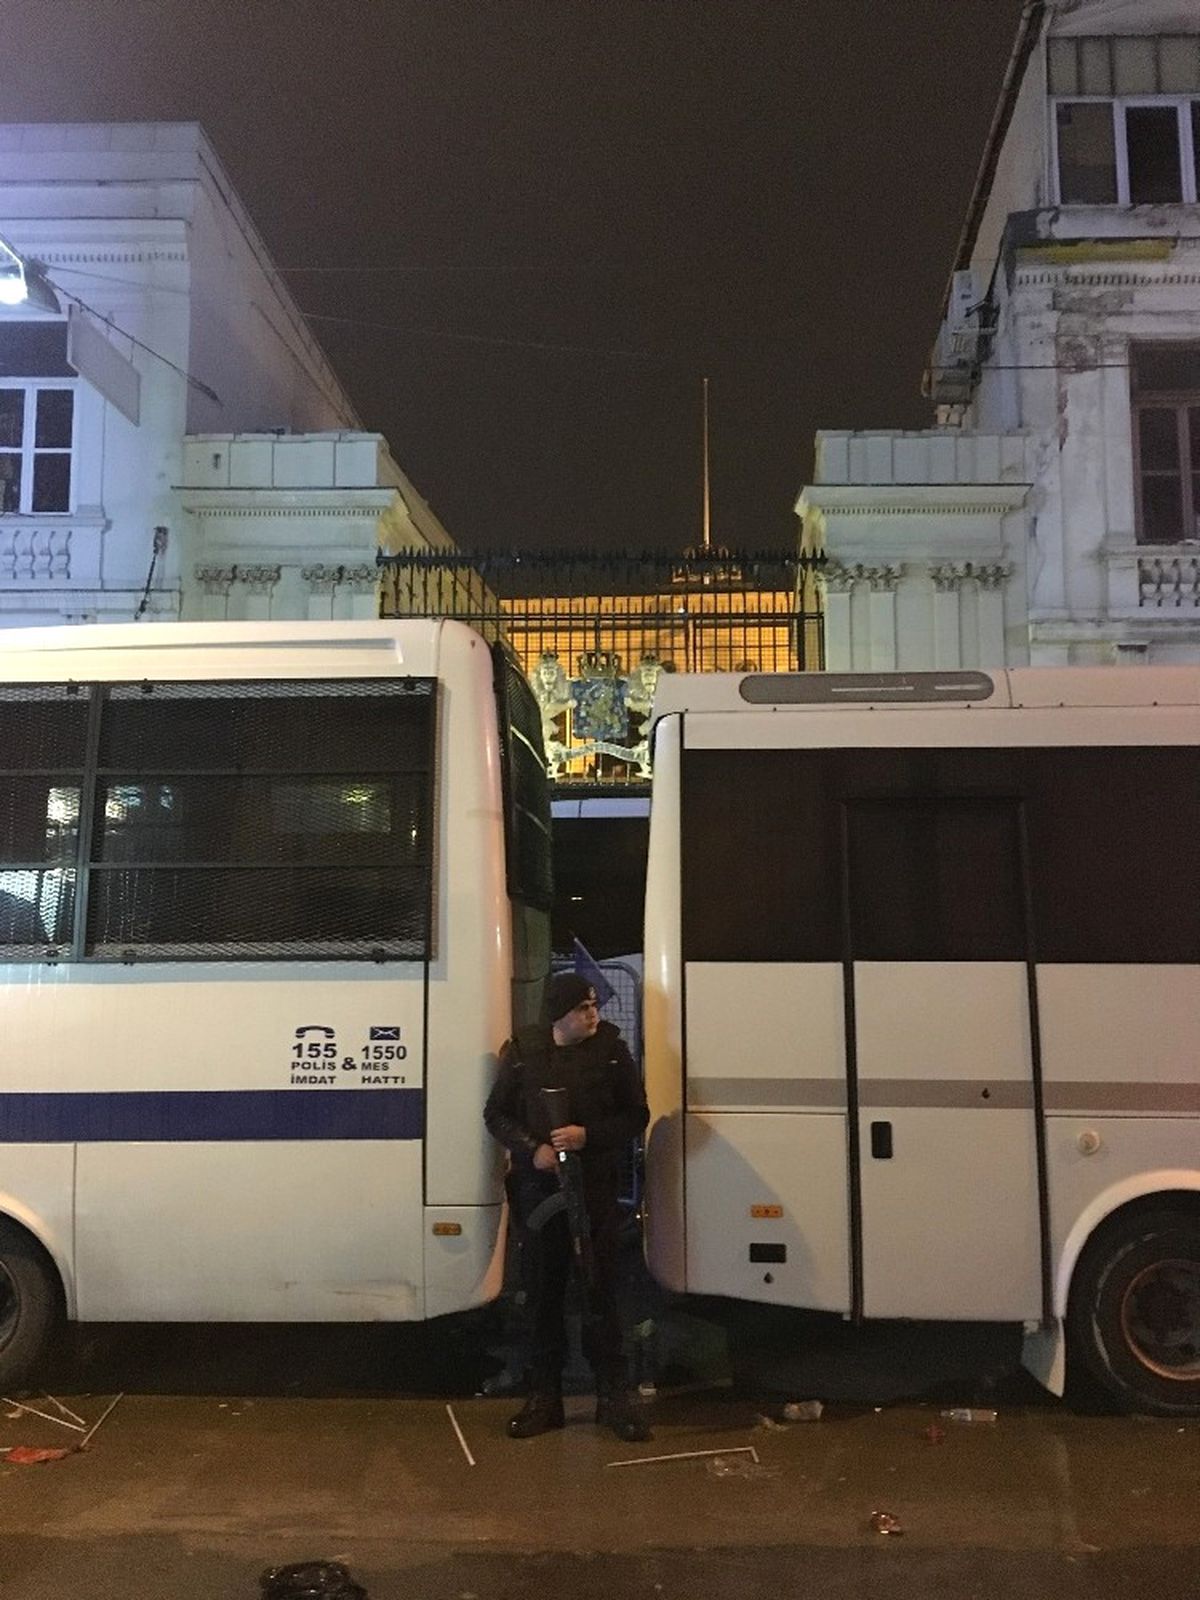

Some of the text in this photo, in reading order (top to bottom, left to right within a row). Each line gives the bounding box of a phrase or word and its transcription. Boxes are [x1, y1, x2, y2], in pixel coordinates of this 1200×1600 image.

[292, 1043, 407, 1060] 155 1550
[291, 1057, 389, 1071] POLİS & MES
[290, 1074, 406, 1084] İMDAT HATTI
